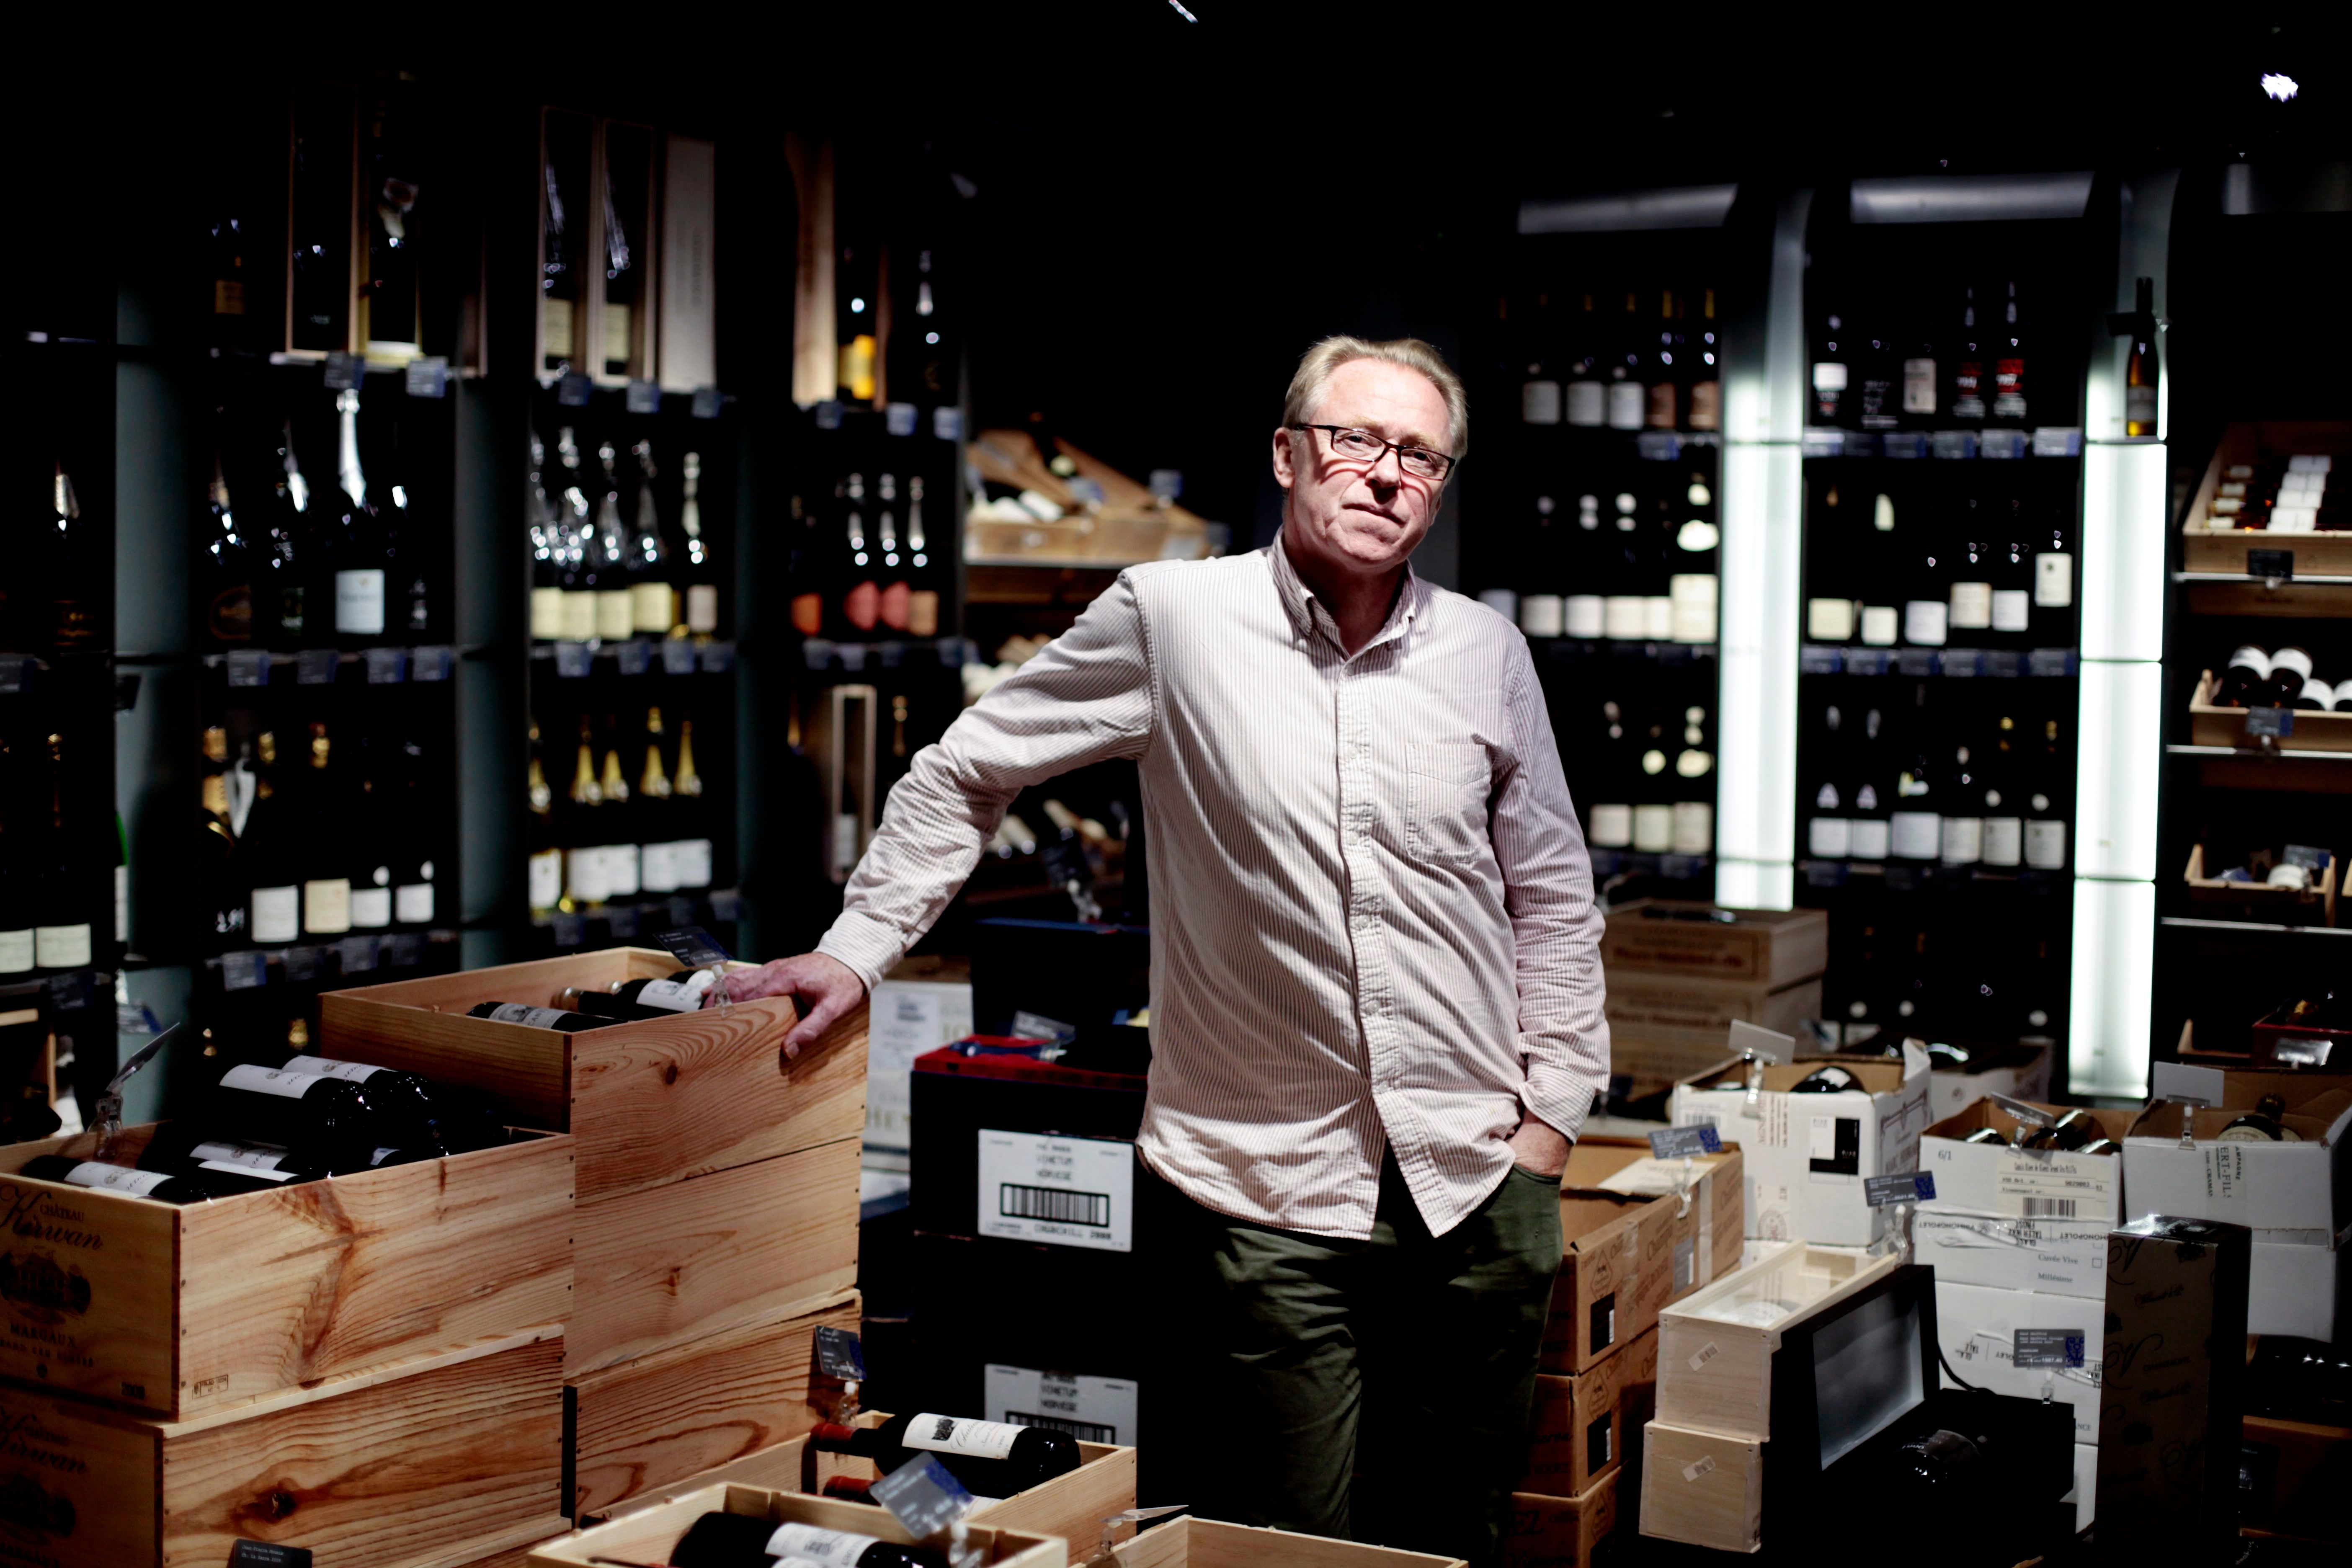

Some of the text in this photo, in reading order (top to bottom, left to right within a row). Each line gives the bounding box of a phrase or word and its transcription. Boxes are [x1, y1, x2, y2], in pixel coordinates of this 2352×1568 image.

[1938, 1150, 1952, 1161] 6/1
[2220, 1146, 2232, 1198] ERT-FIL
[0, 1184, 103, 1251] Kirwan
[39, 1203, 84, 1222] CHÂTEAU
[2038, 1253, 2079, 1265] Cuvée Vive
[2037, 1271, 2073, 1283] Millésime
[10, 1323, 76, 1348] MARGAUX
[0, 1339, 26, 1352] RAND
[2143, 1356, 2191, 1372] CHAMPAGNE
